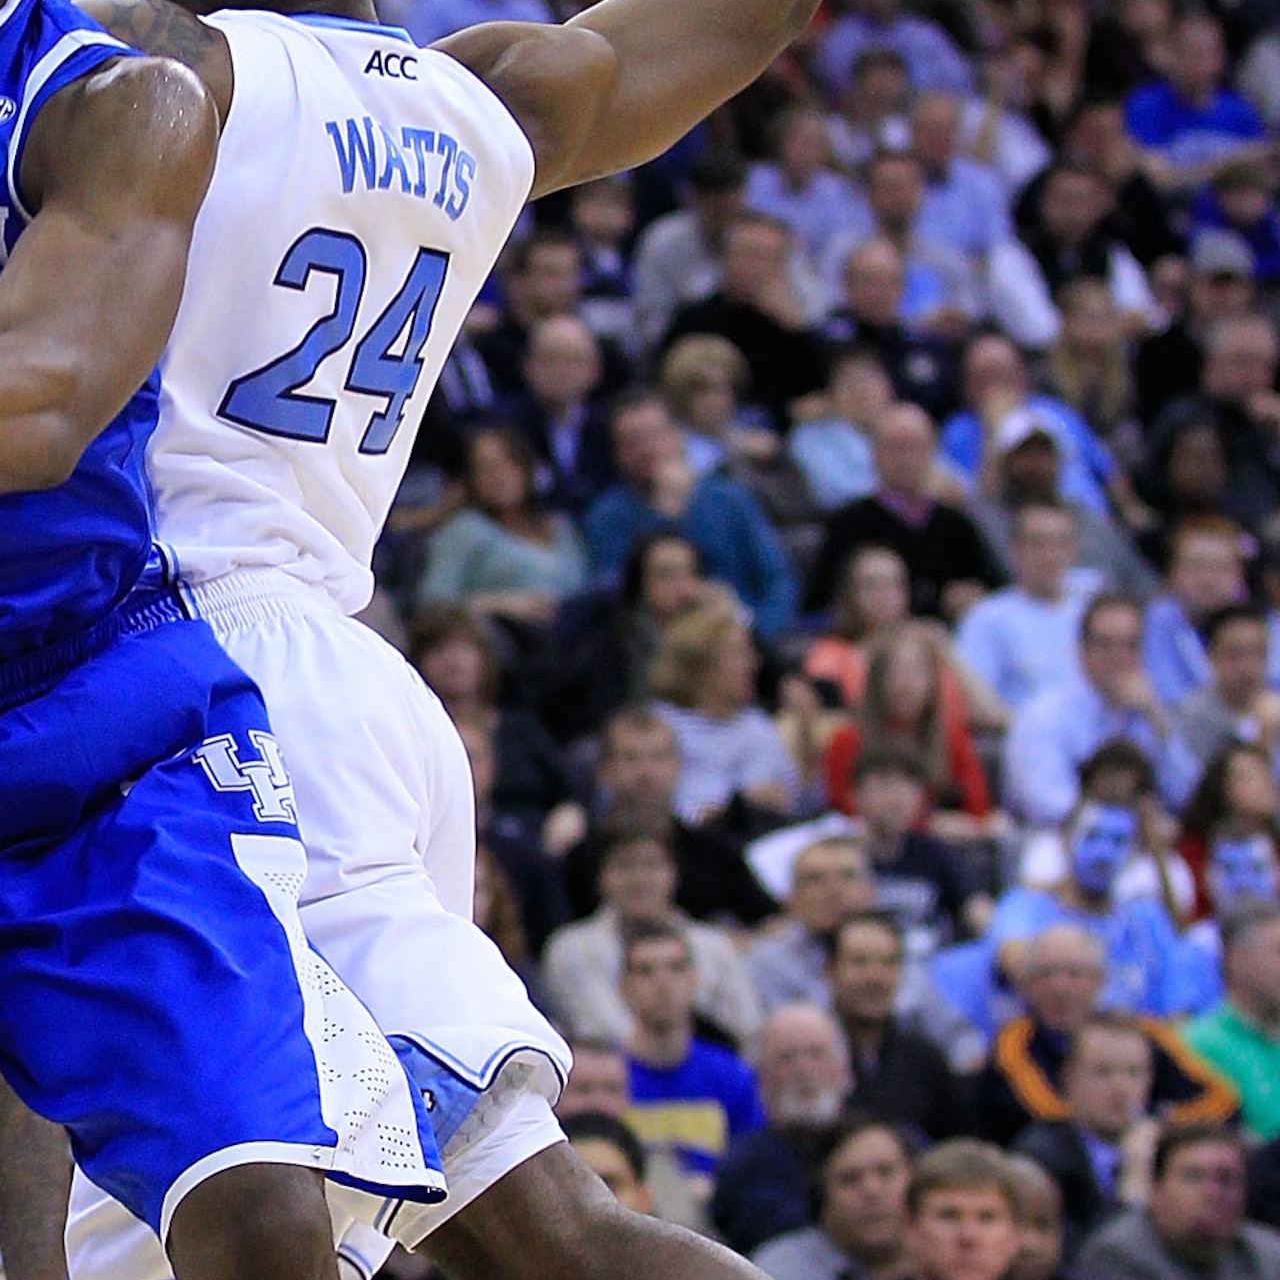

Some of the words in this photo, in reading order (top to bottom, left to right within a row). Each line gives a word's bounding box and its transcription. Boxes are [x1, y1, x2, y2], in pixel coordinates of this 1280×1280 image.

[363, 49, 418, 80] ACC
[326, 116, 477, 220] WATTS
[216, 226, 452, 455] 24
